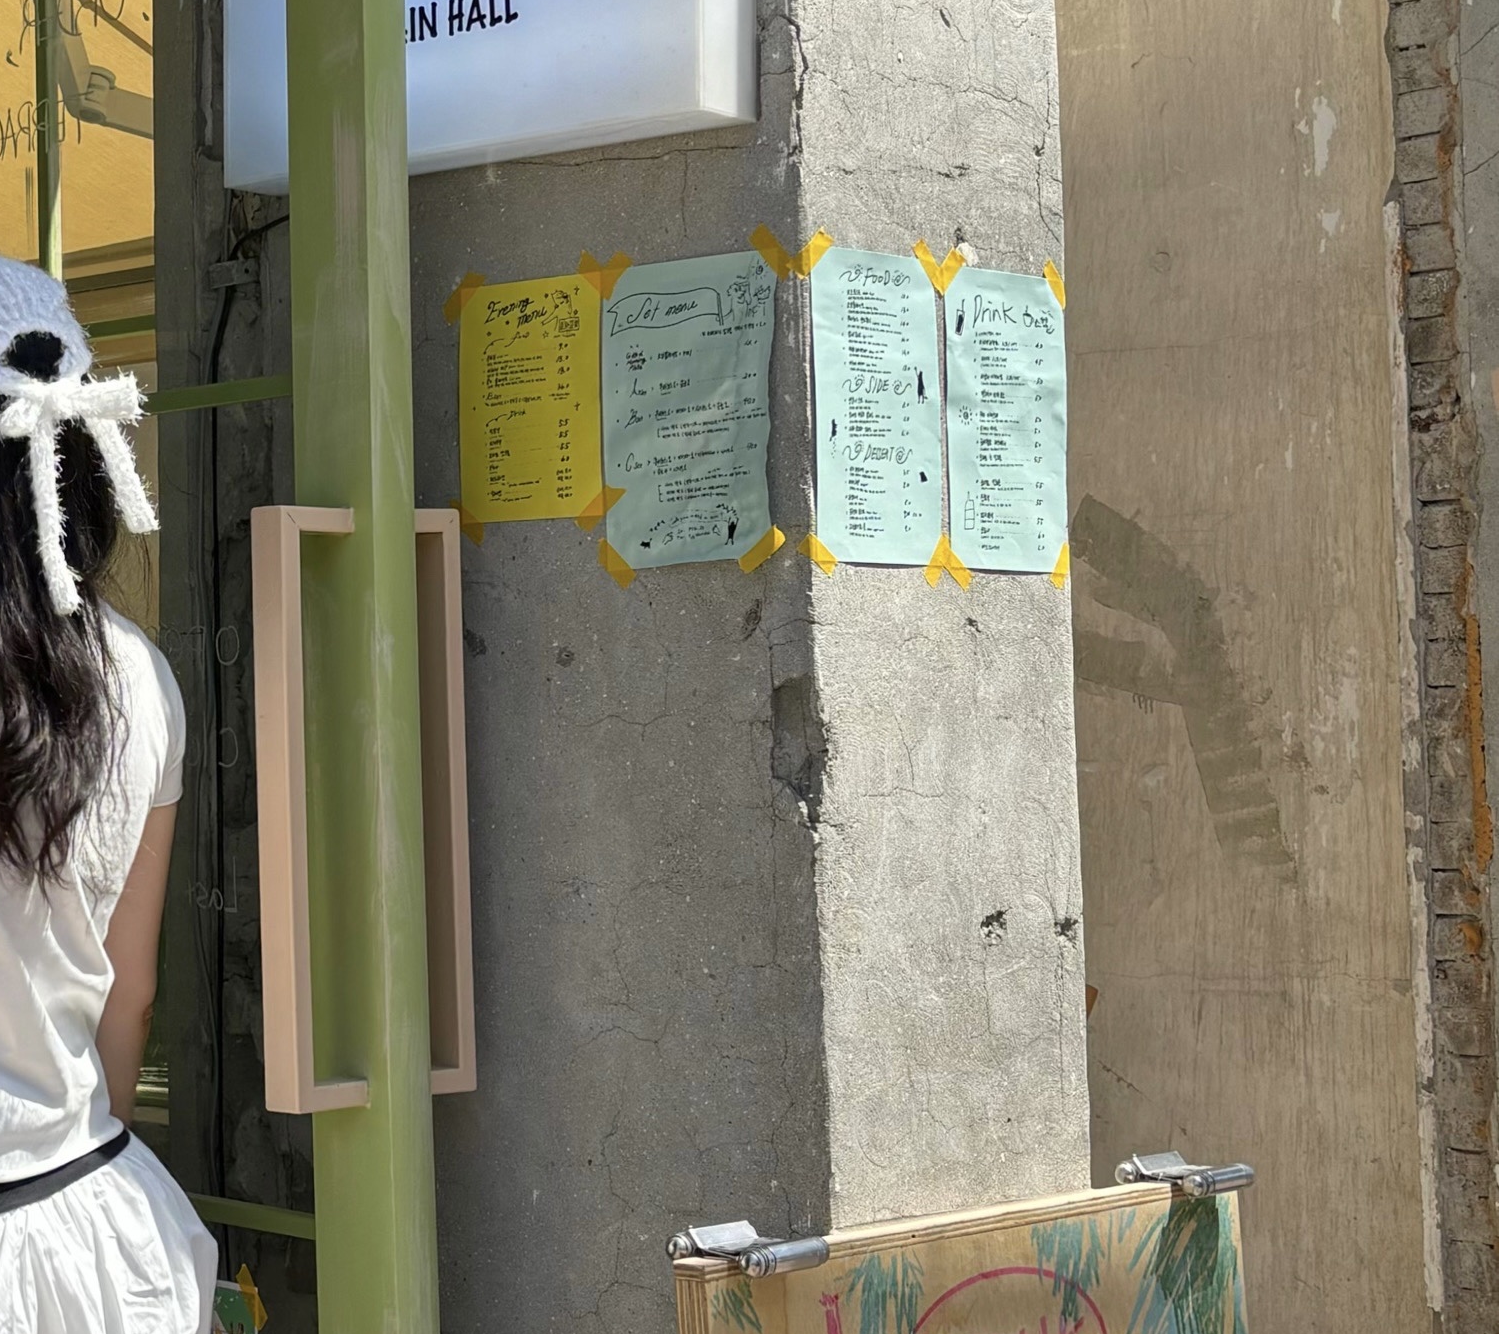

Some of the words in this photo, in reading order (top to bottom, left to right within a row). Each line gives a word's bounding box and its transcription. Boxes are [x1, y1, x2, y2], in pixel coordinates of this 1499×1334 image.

[404, 2, 438, 44] IN
[863, 267, 891, 286] FOOD
[627, 297, 661, 324] Set
[665, 300, 699, 317] menu
[972, 294, 1017, 329] Drink
[864, 375, 890, 394] SIDE
